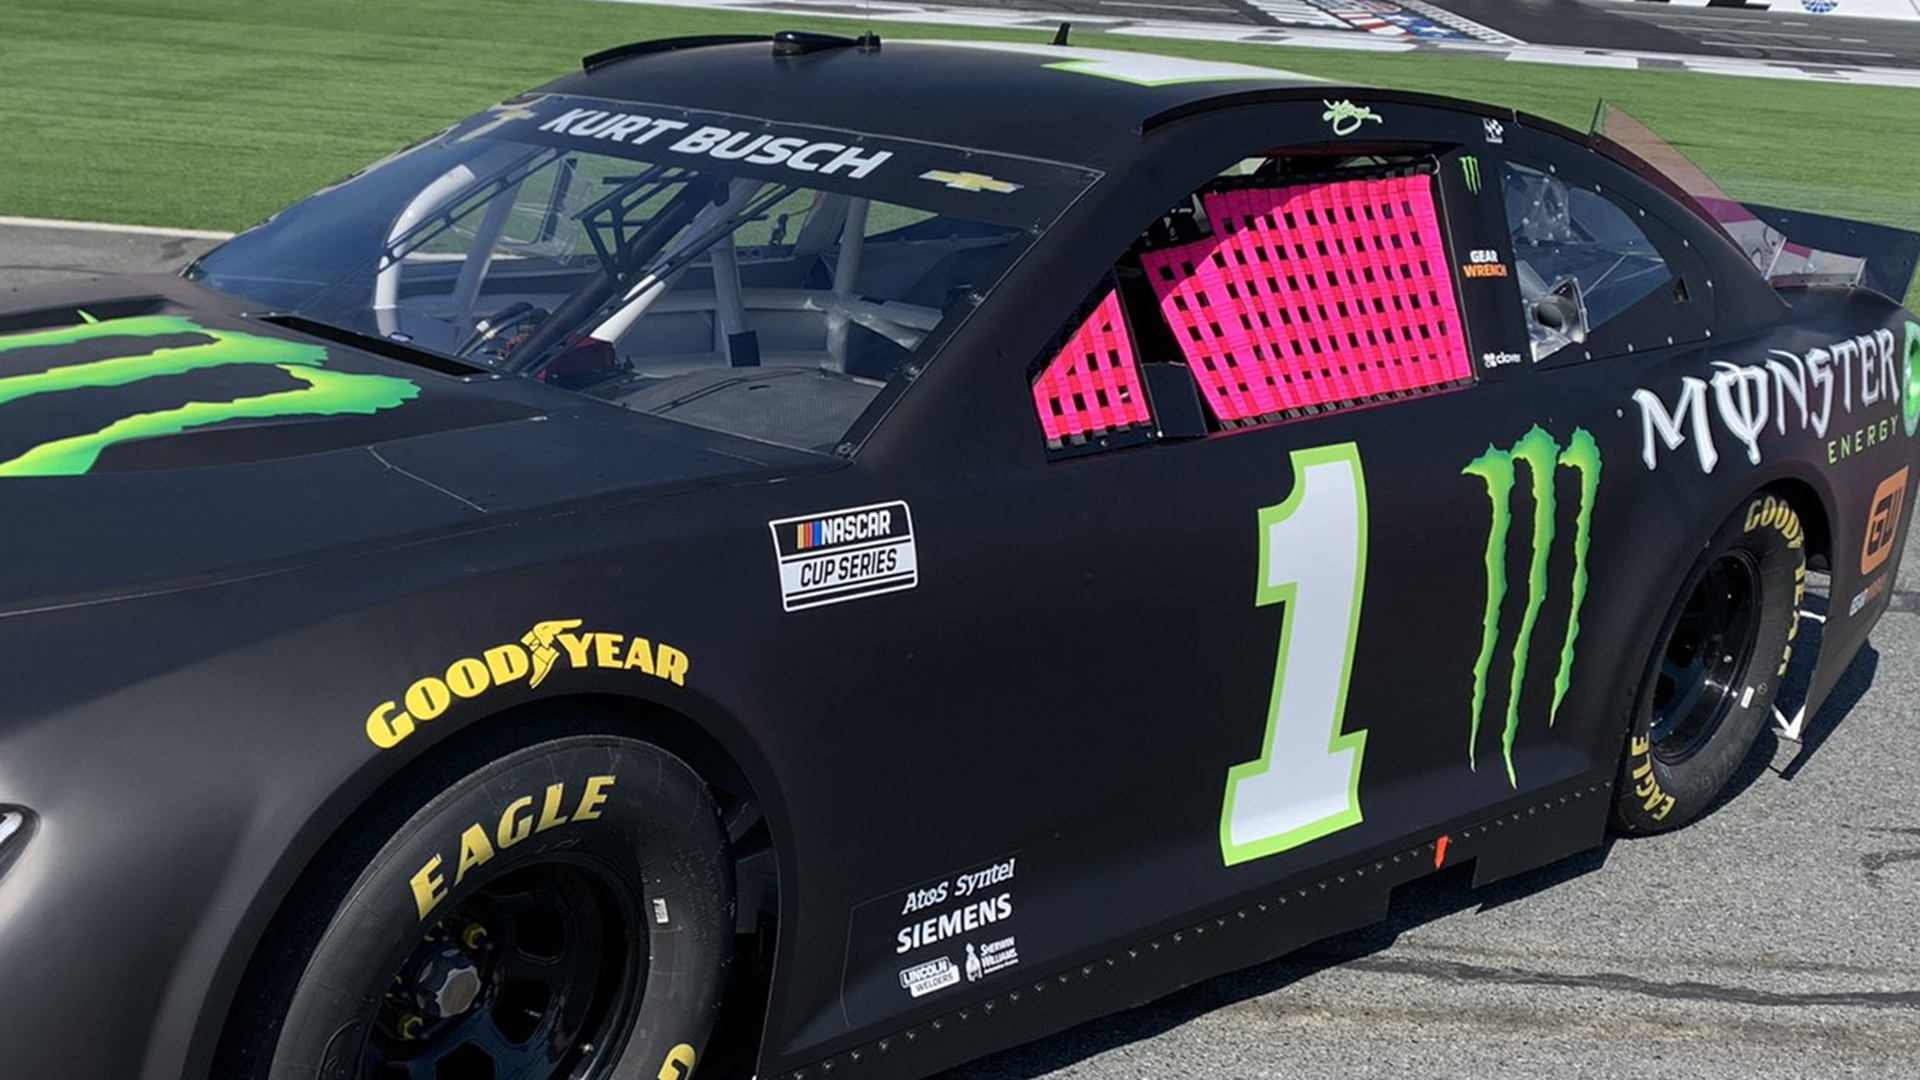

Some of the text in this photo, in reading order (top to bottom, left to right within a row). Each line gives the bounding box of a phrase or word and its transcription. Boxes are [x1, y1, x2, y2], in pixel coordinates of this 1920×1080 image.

[539, 107, 893, 180] KURT BUSCH
[1463, 264, 1507, 278] WRENCH
[1470, 250, 1499, 263] GEAR
[1631, 327, 1900, 474] MONSTER
[1827, 414, 1899, 464] ENERGY
[821, 510, 891, 545] NASCAR
[800, 548, 898, 588] CUP SERIES
[1219, 442, 1368, 867] 1
[365, 618, 690, 750] GOODYEAR
[1631, 735, 1676, 821] EAGLE
[408, 775, 616, 922] EAGLE
[954, 858, 1016, 896] Syntel
[896, 893, 1013, 954] SIEMENS
[903, 959, 948, 985] LINCOLN
[915, 971, 953, 992] WELDERS
